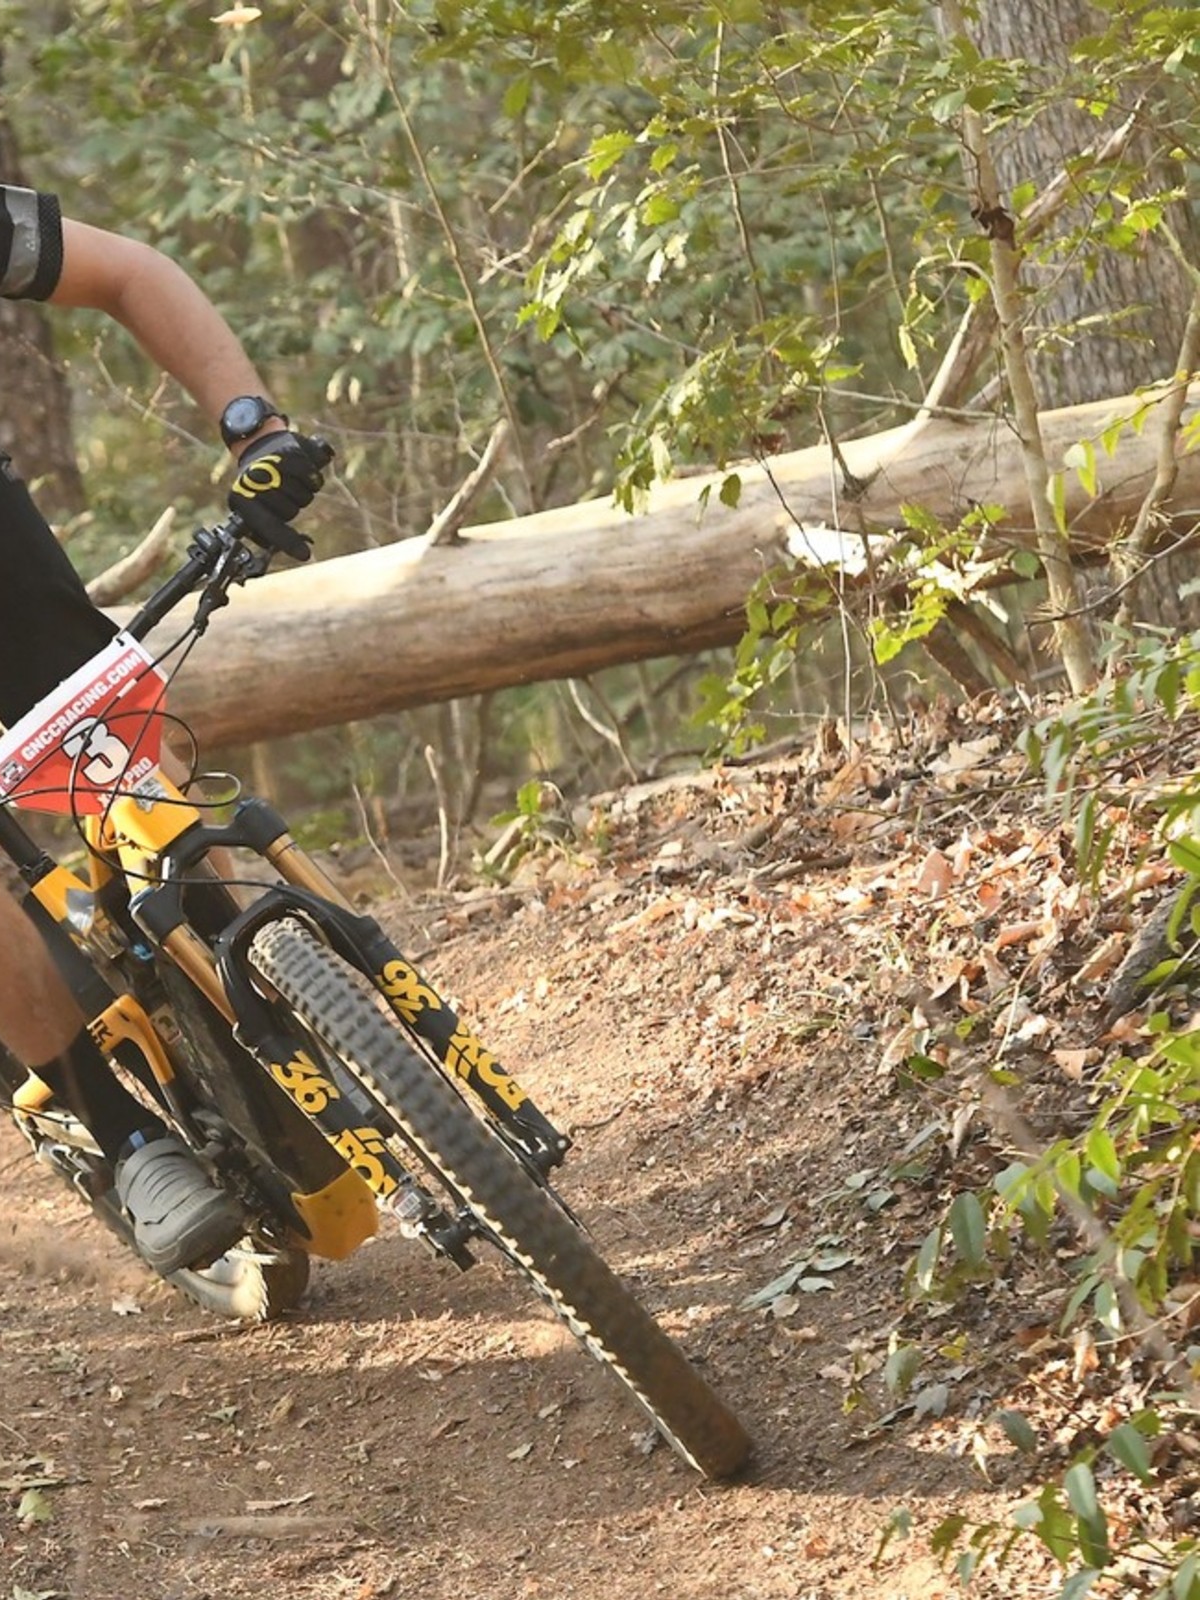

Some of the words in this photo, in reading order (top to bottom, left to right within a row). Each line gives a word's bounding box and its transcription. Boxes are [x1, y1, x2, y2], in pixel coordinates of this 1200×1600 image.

[21, 651, 142, 761] GNCCRACING.COM
[61, 717, 130, 784] 3
[376, 960, 441, 1024] 36
[271, 1050, 340, 1113] 36
